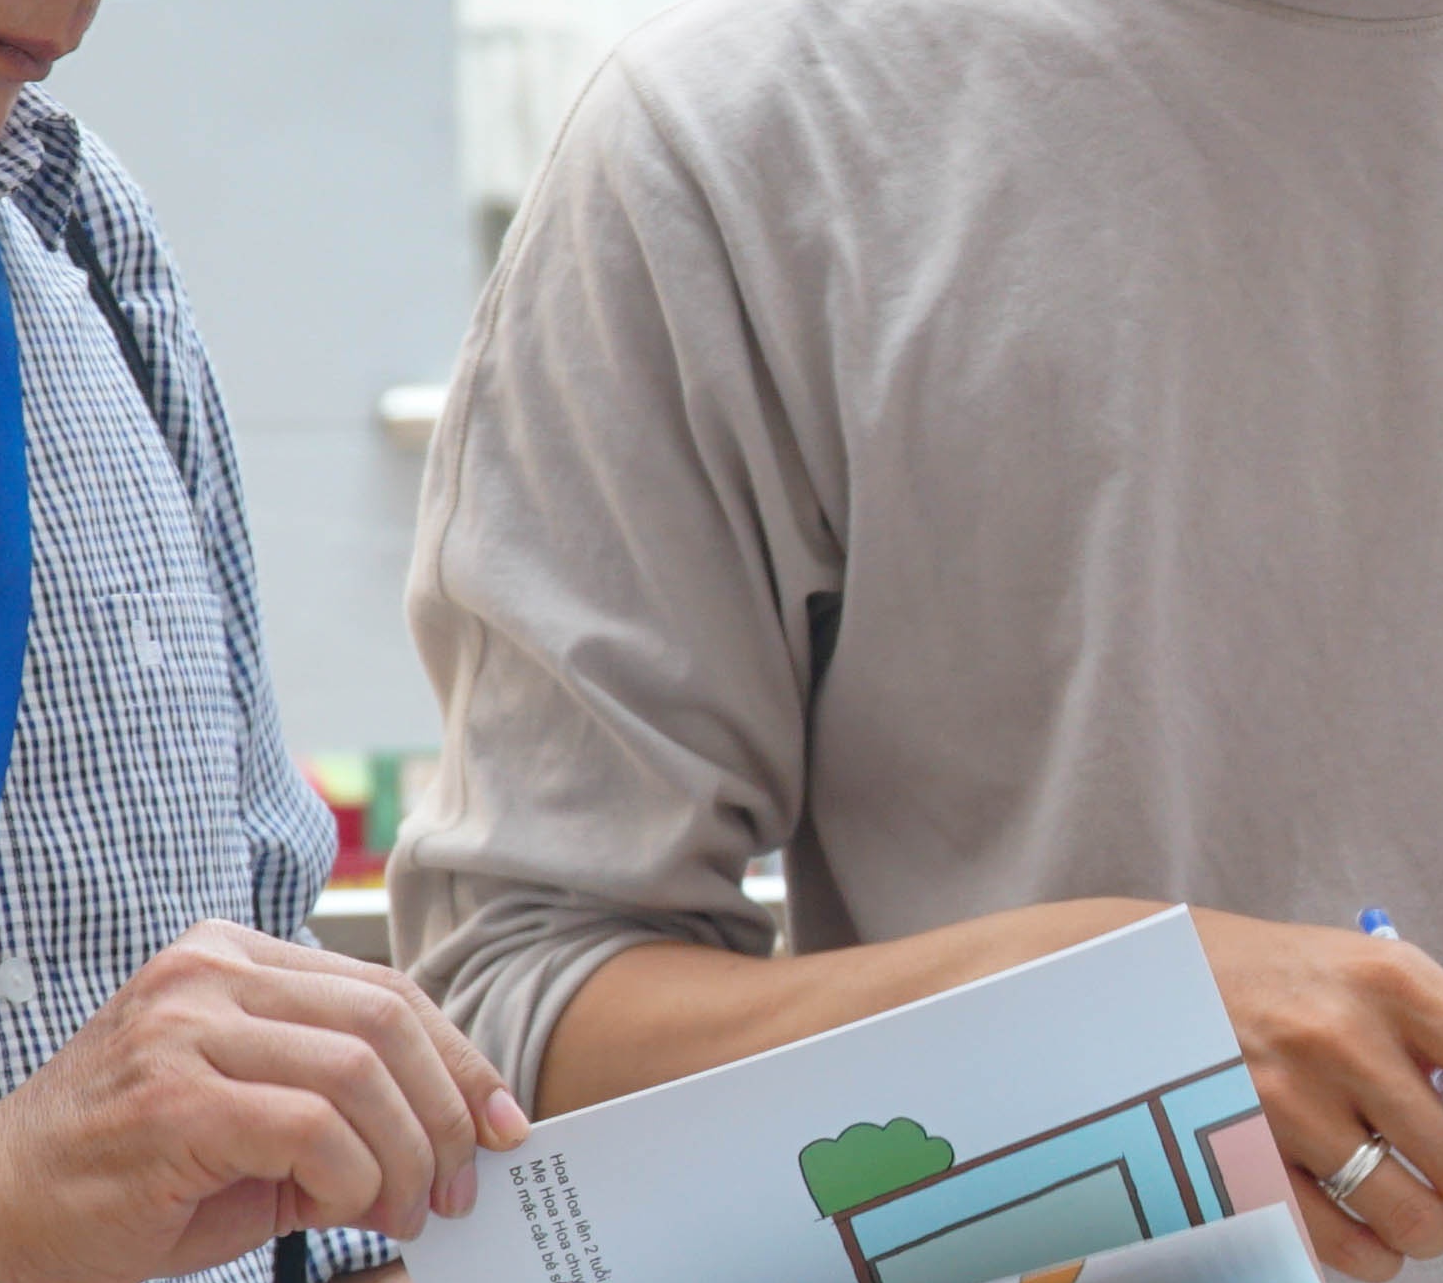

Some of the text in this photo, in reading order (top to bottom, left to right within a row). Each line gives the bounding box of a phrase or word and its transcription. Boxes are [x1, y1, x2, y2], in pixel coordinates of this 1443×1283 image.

[509, 1165, 527, 1186] bỏ
[550, 1153, 569, 1185] Hoa
[517, 1189, 538, 1221] mặc
[529, 1159, 546, 1184] Mẹ
[539, 1186, 558, 1218] Hoa
[552, 1220, 571, 1250] Hoa
[562, 1187, 581, 1218] Hoa
[531, 1224, 548, 1250] cậu
[575, 1219, 591, 1242] lên
[541, 1251, 559, 1271] bé
[584, 1245, 598, 1255] 2
[589, 1257, 612, 1282] tuổi
